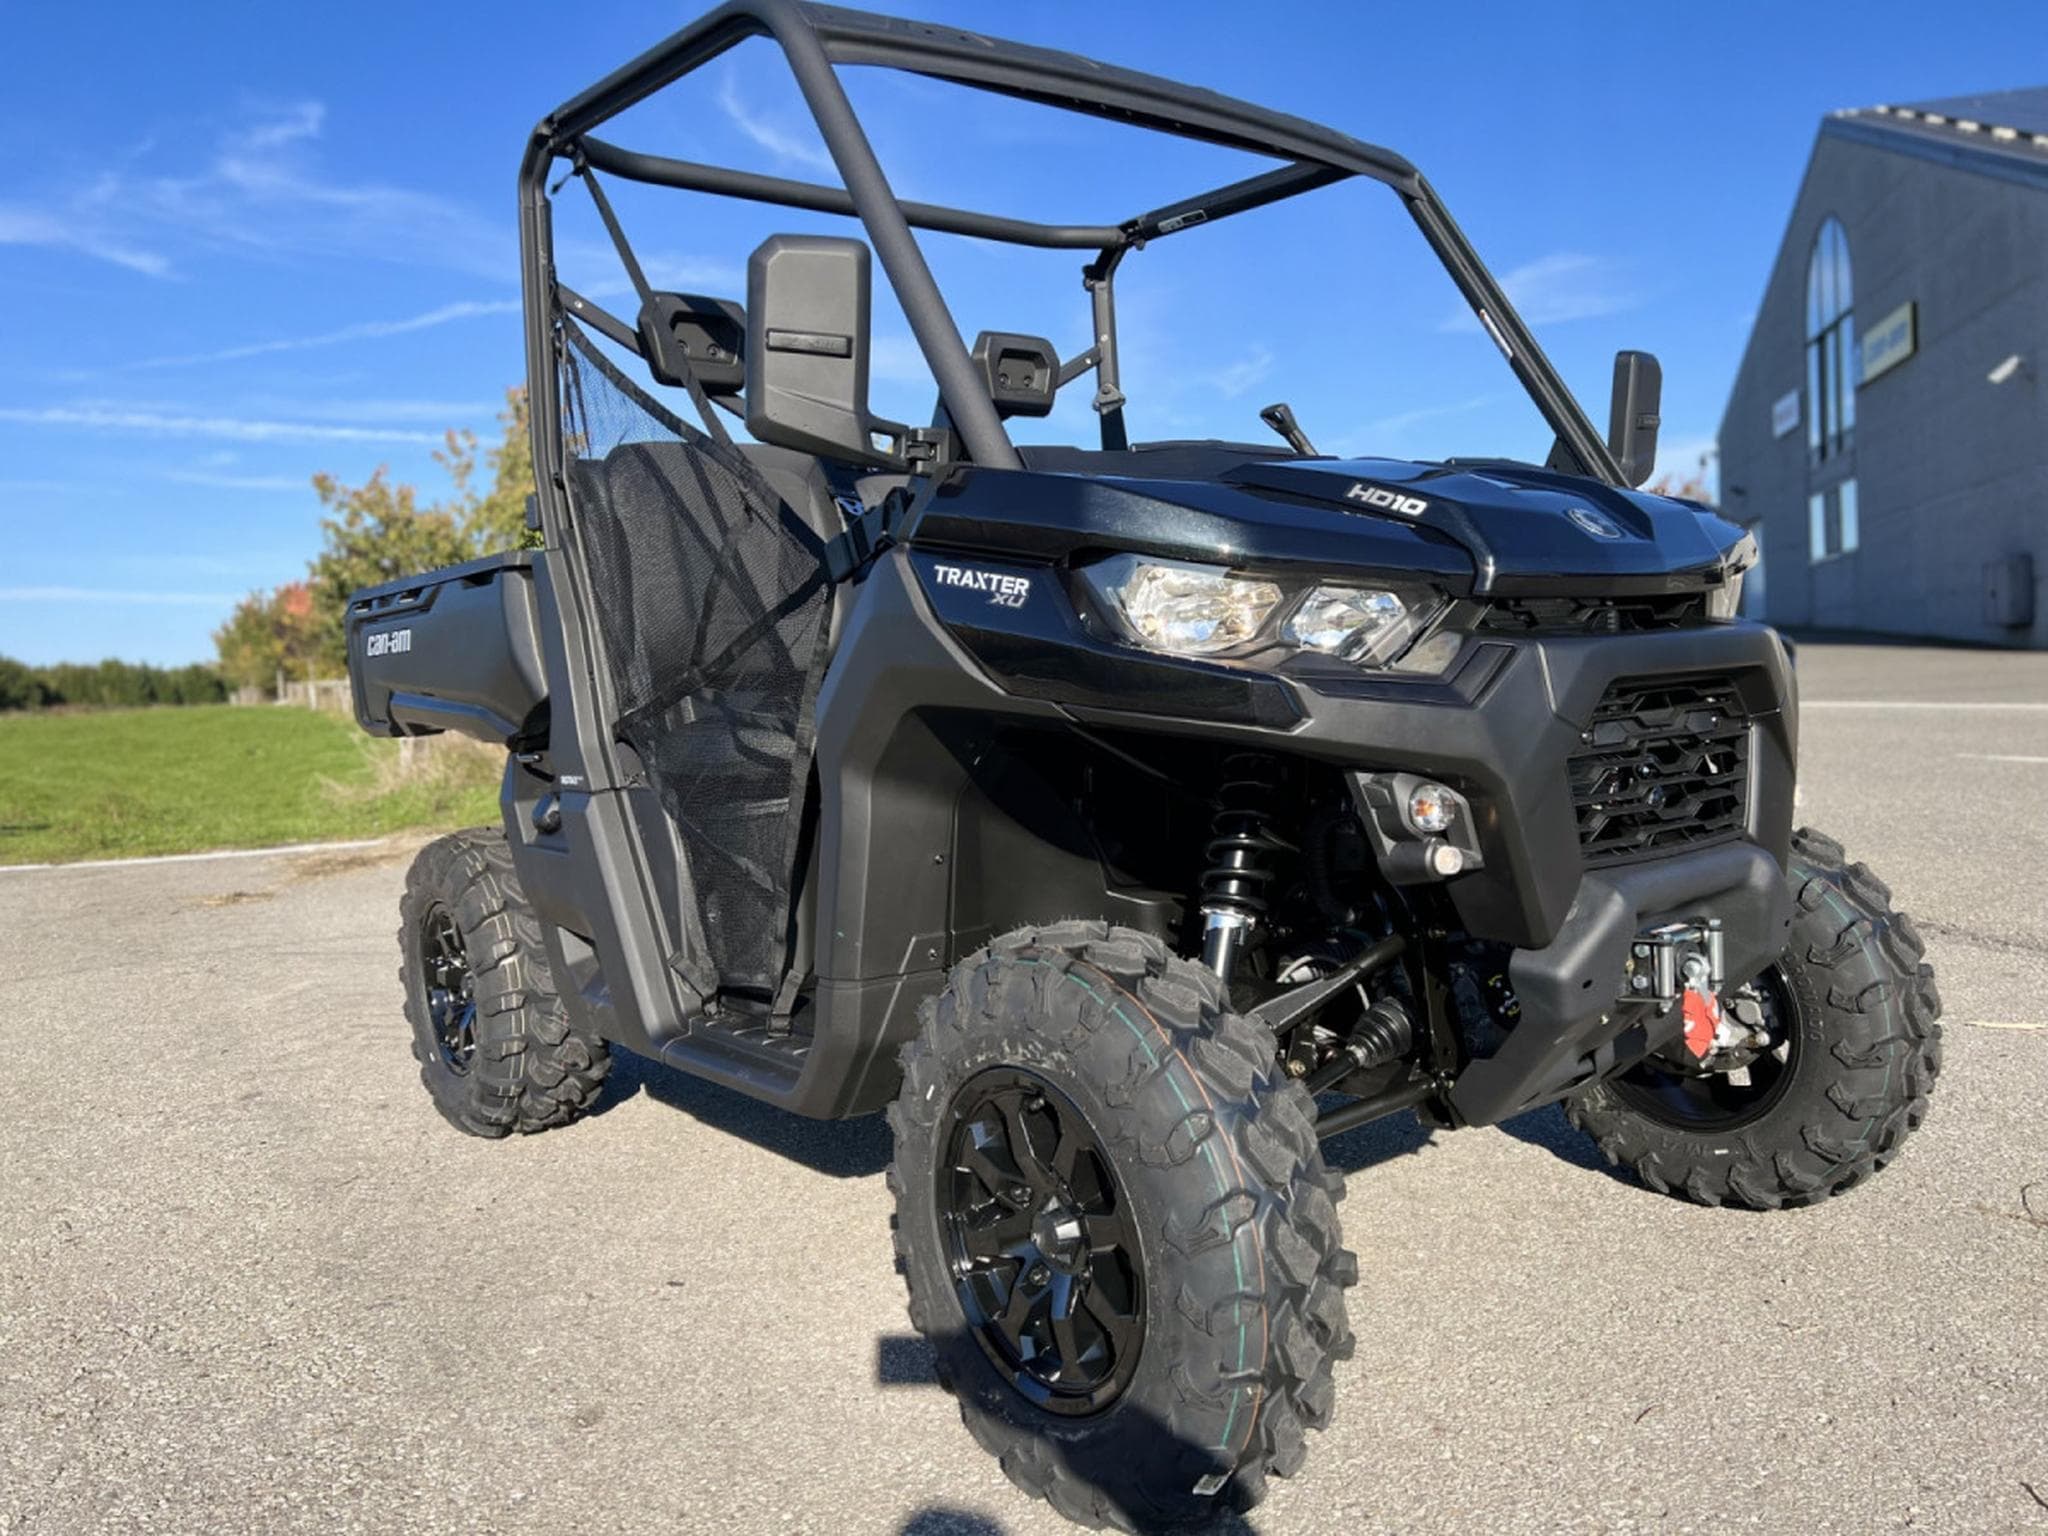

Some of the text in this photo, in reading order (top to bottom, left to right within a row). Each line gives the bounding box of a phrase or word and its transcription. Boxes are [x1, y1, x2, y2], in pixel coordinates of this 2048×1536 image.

[1347, 483, 1428, 516] HD10
[934, 565, 1030, 596] TRAXTER
[367, 629, 411, 656] can-am
